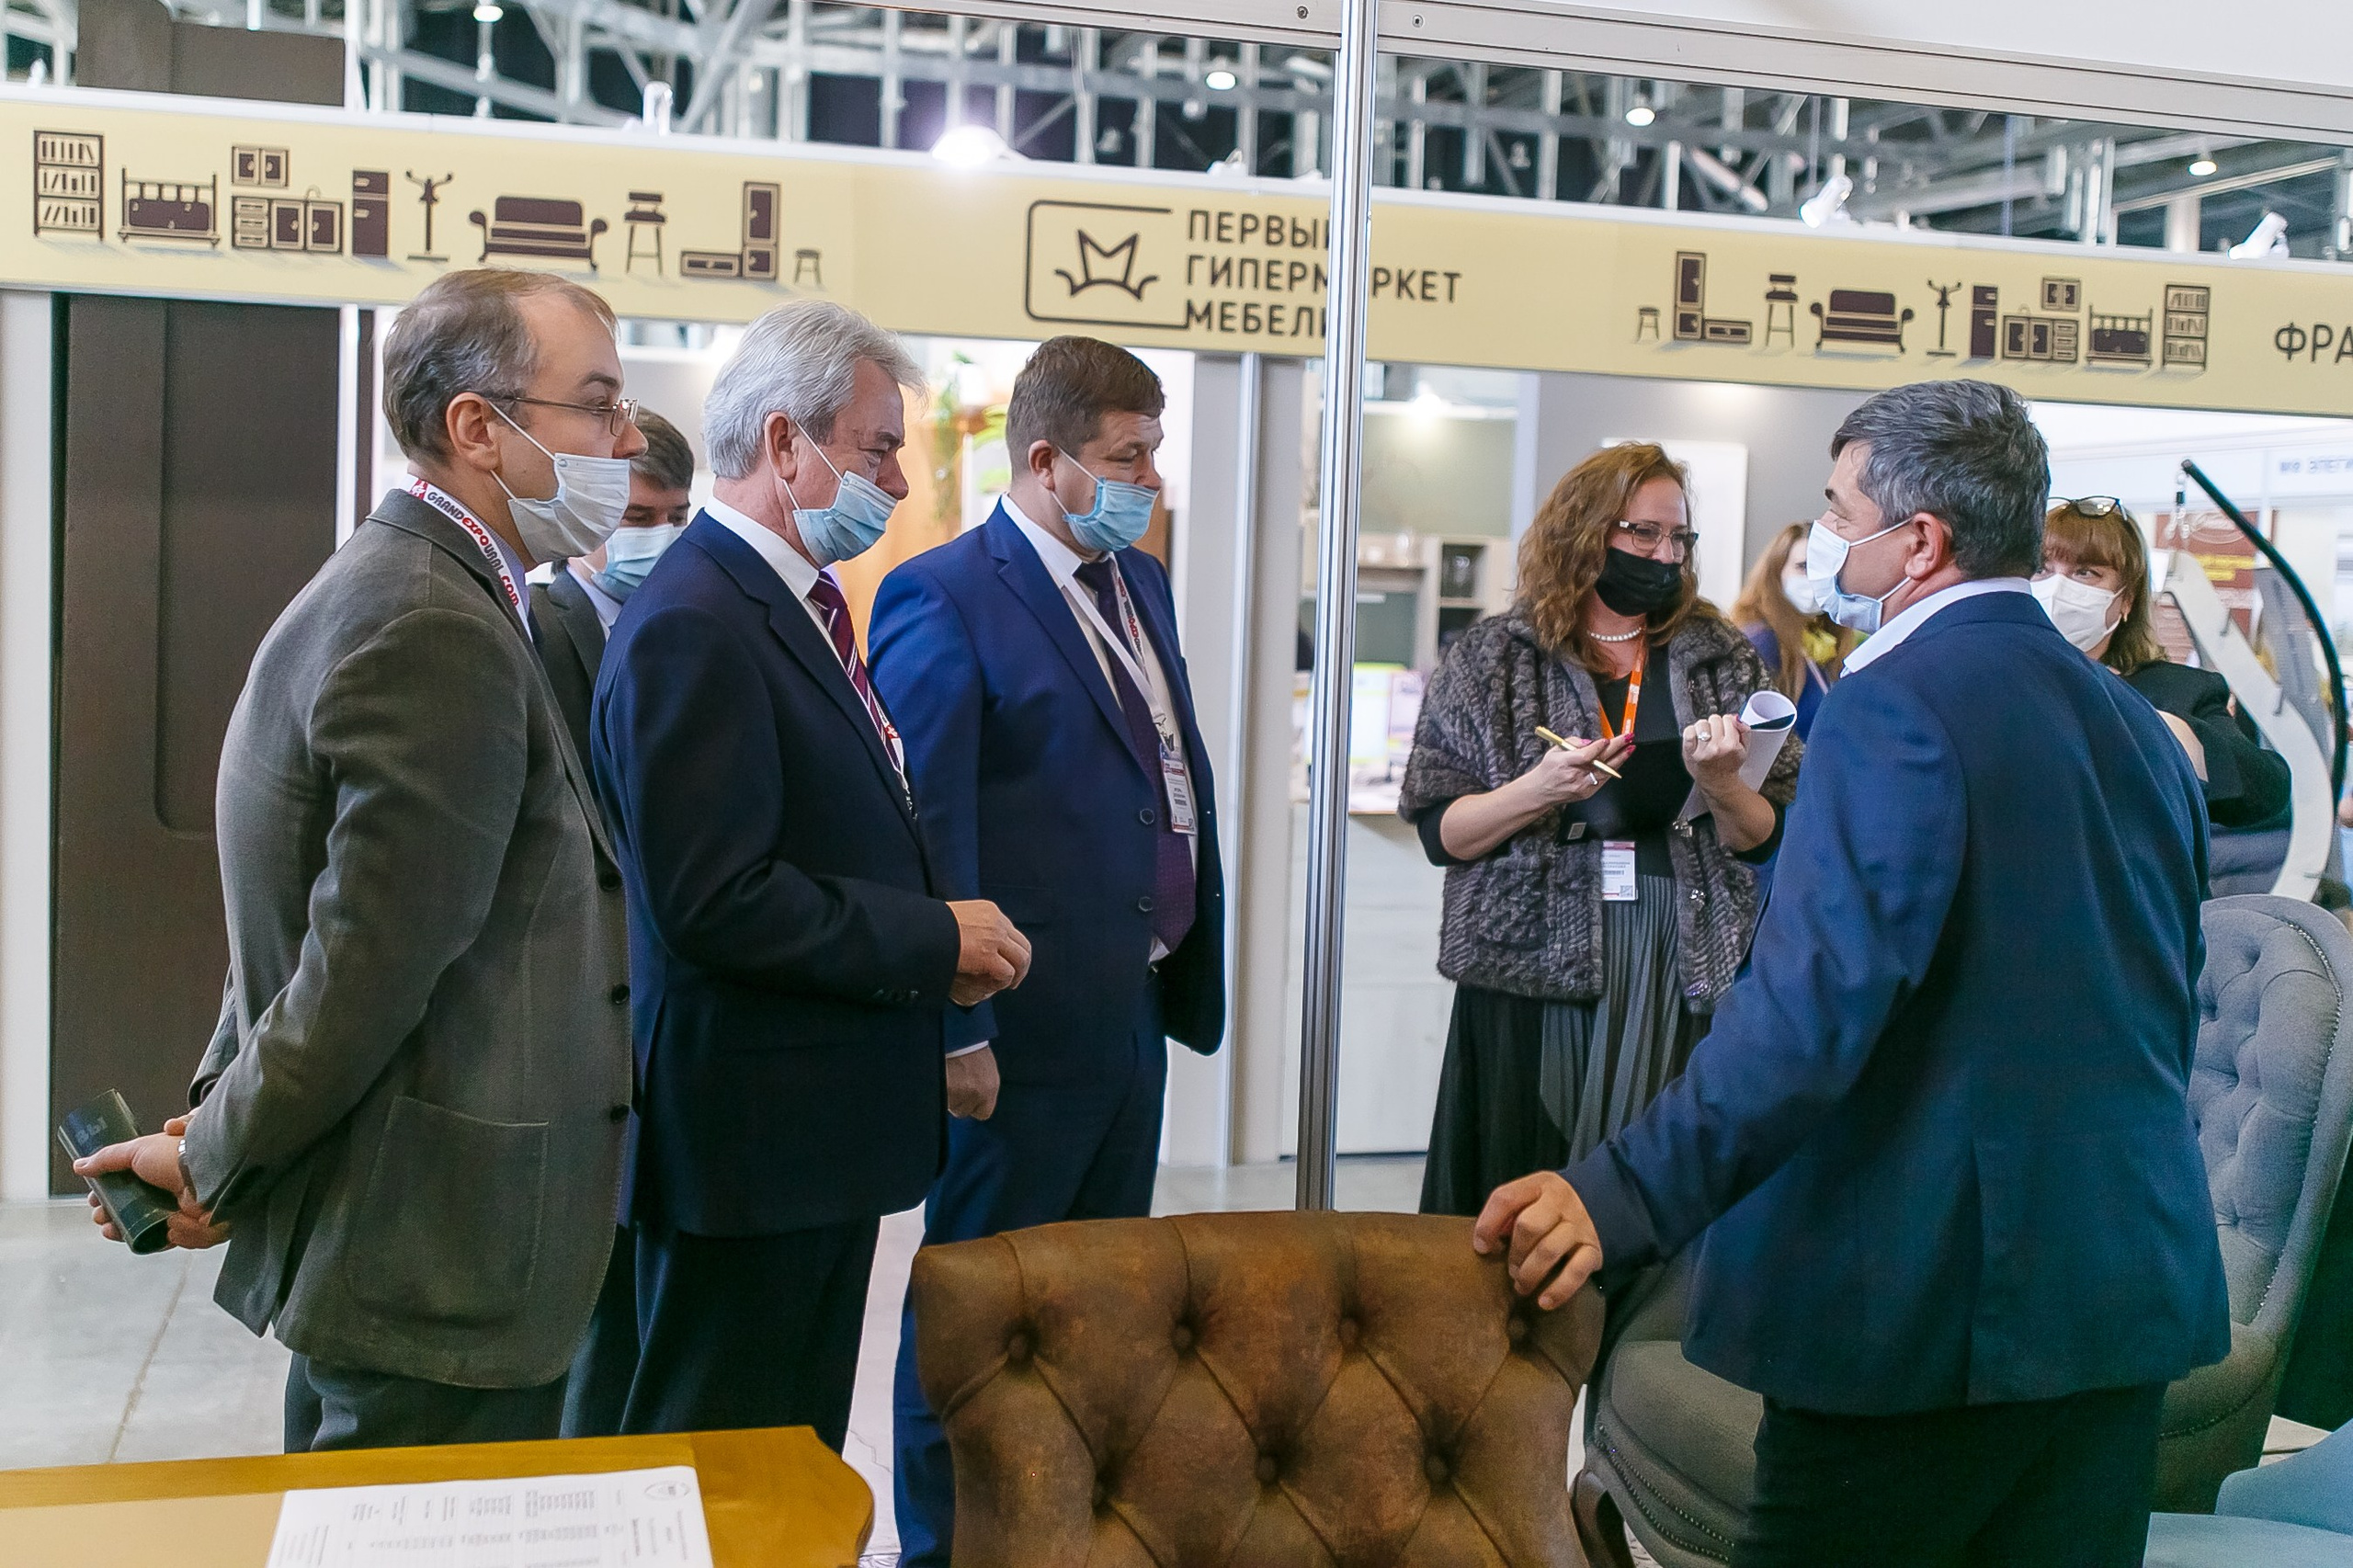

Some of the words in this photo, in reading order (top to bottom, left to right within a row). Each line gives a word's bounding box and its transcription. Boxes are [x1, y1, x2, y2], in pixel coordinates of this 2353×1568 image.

[1189, 210, 1329, 250] ПЕРВЫ
[1187, 255, 1461, 302] ГИПЕРМРКЕТ
[1186, 300, 1326, 338] МЕБЕЛ
[2275, 322, 2353, 363] ФРА
[427, 492, 519, 606] GRANDEXPOURALCOM
